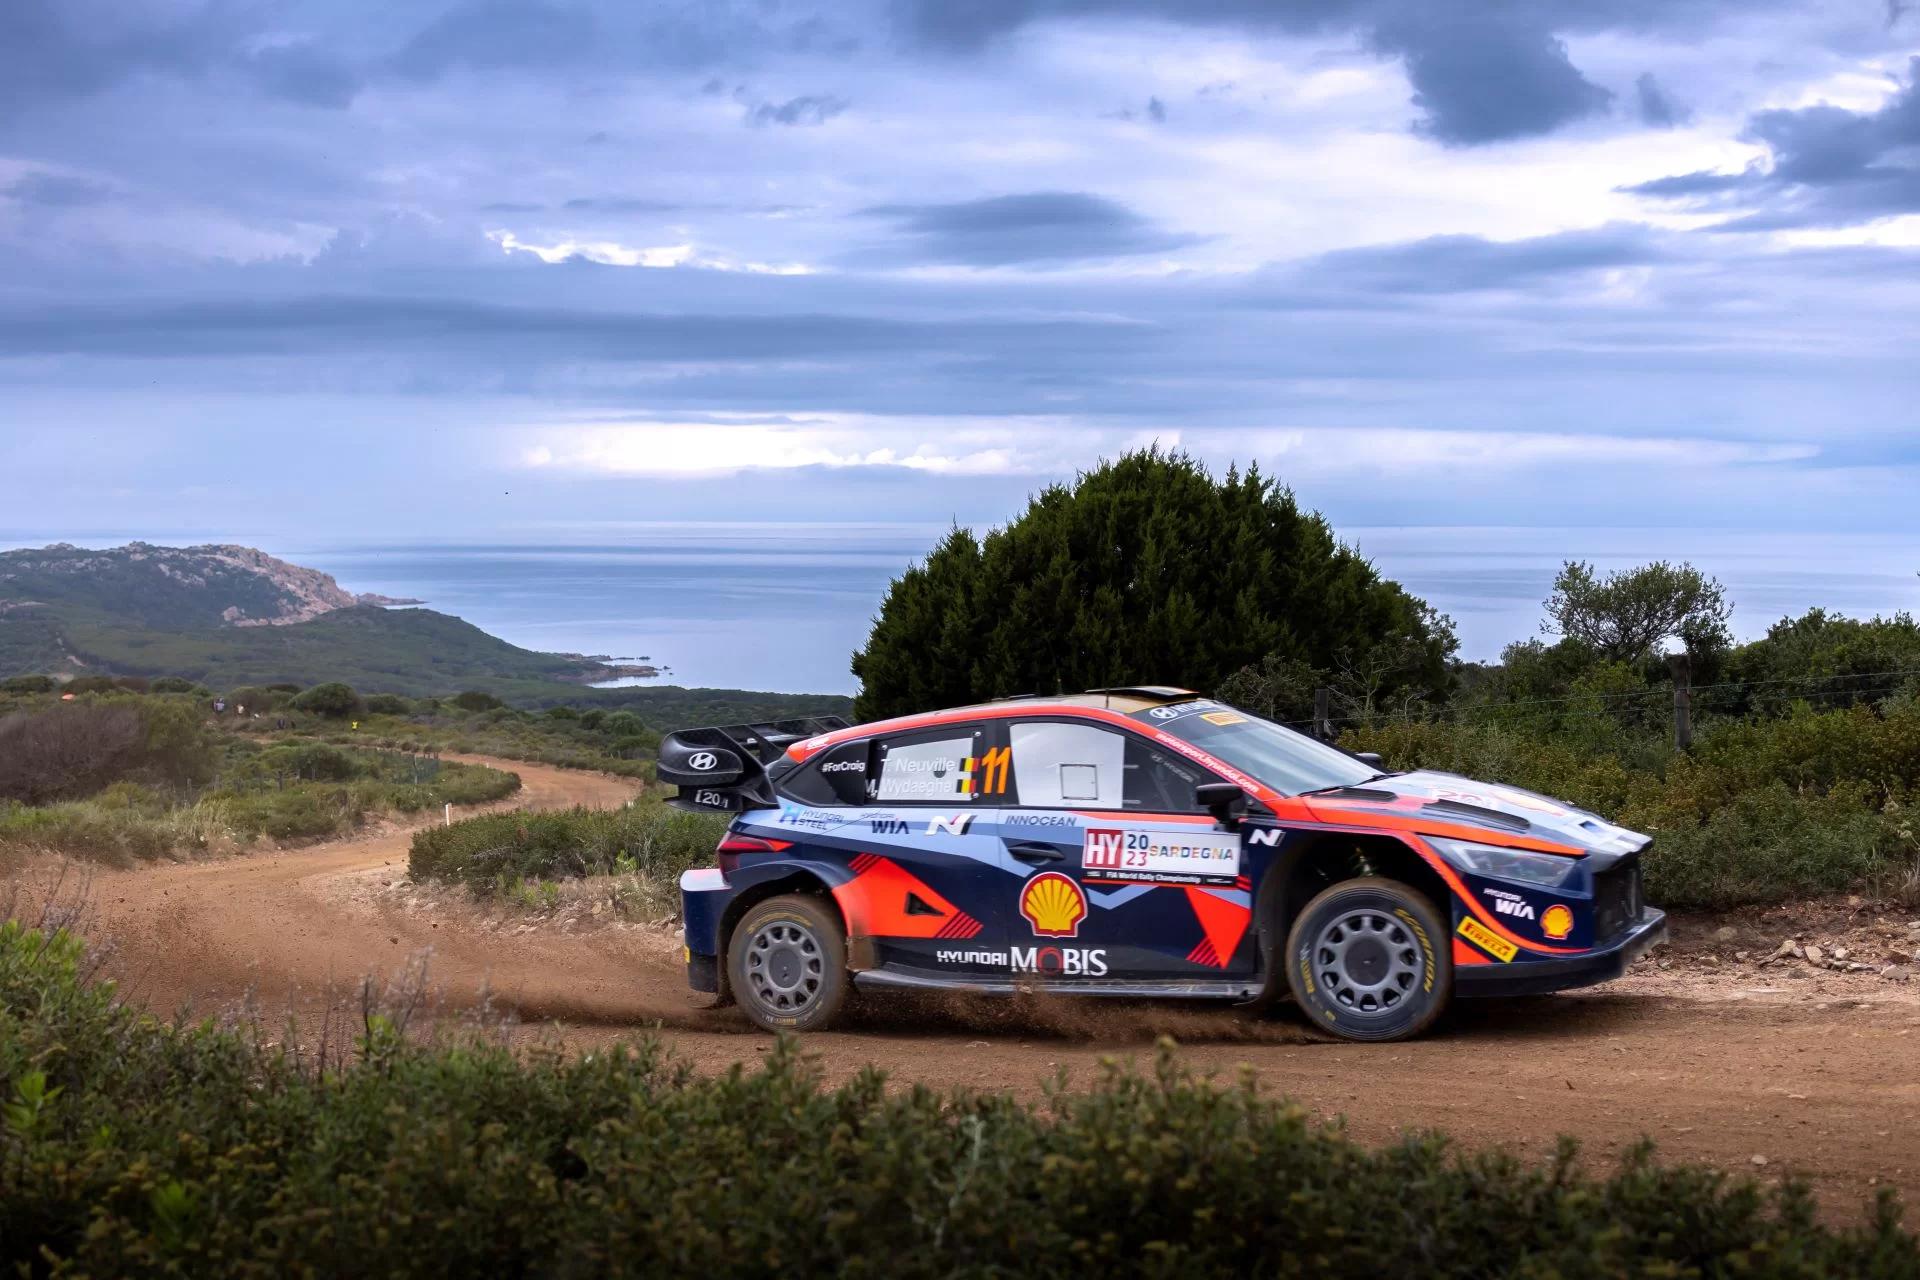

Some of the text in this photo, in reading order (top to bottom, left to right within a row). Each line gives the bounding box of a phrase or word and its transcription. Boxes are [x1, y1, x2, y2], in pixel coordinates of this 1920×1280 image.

[822, 760, 866, 772] #ForCraig
[895, 757, 957, 772] Neuville
[982, 747, 1012, 794] 11
[798, 818, 828, 831] STEEL
[1005, 815, 1077, 828] INNOCEAN
[1127, 834, 1149, 850] 20
[1125, 851, 1148, 867] 23
[1150, 845, 1234, 861] SARDEGNA
[936, 946, 1108, 977] HYUNDAI MOBIS
